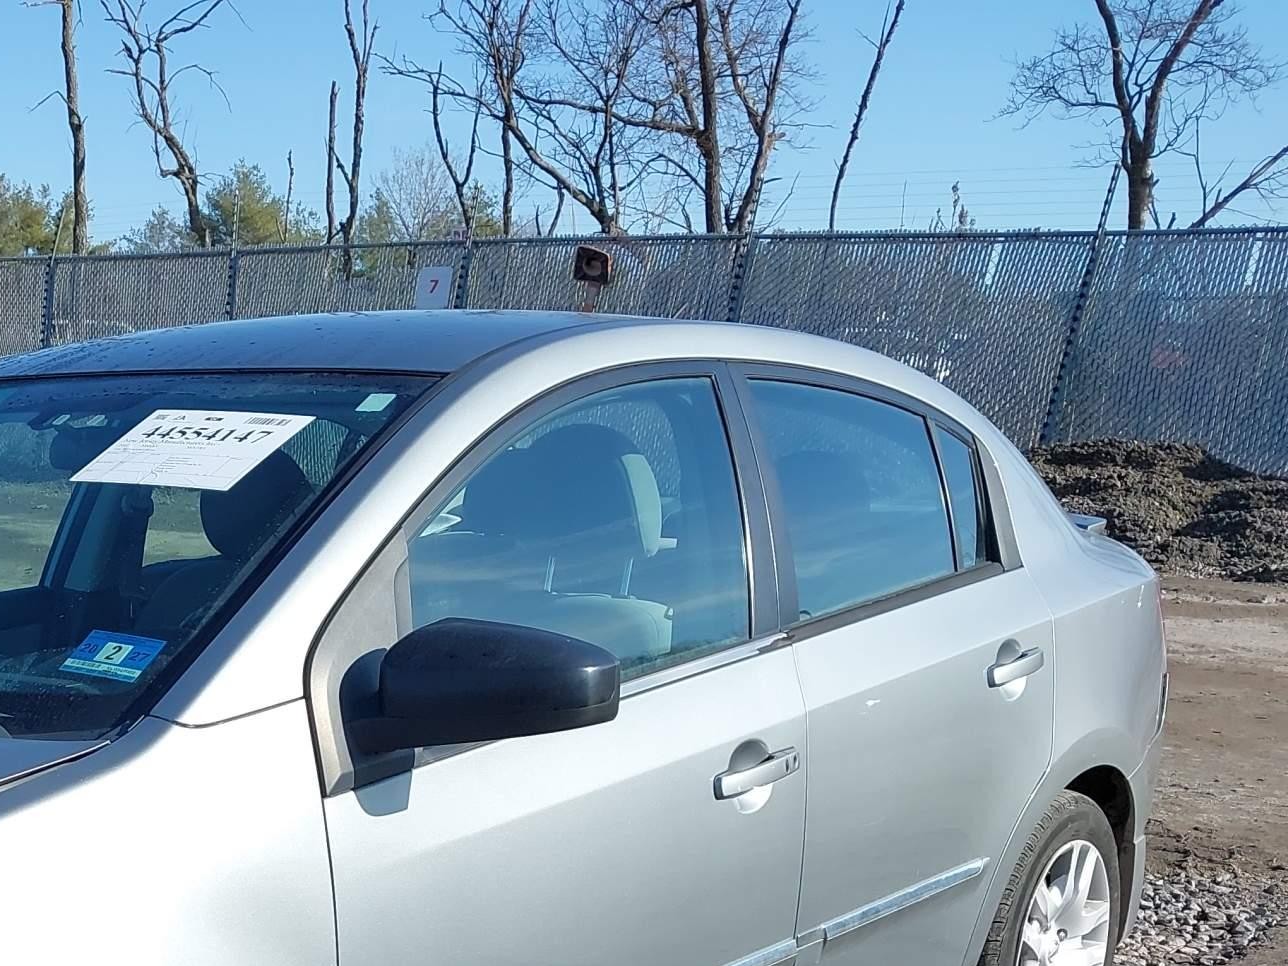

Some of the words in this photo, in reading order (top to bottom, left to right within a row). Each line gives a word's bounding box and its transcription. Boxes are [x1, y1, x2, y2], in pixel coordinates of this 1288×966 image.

[429, 279, 440, 293] 7
[141, 425, 274, 444] 44554147
[103, 645, 123, 660] 2
[128, 651, 150, 662] 27
